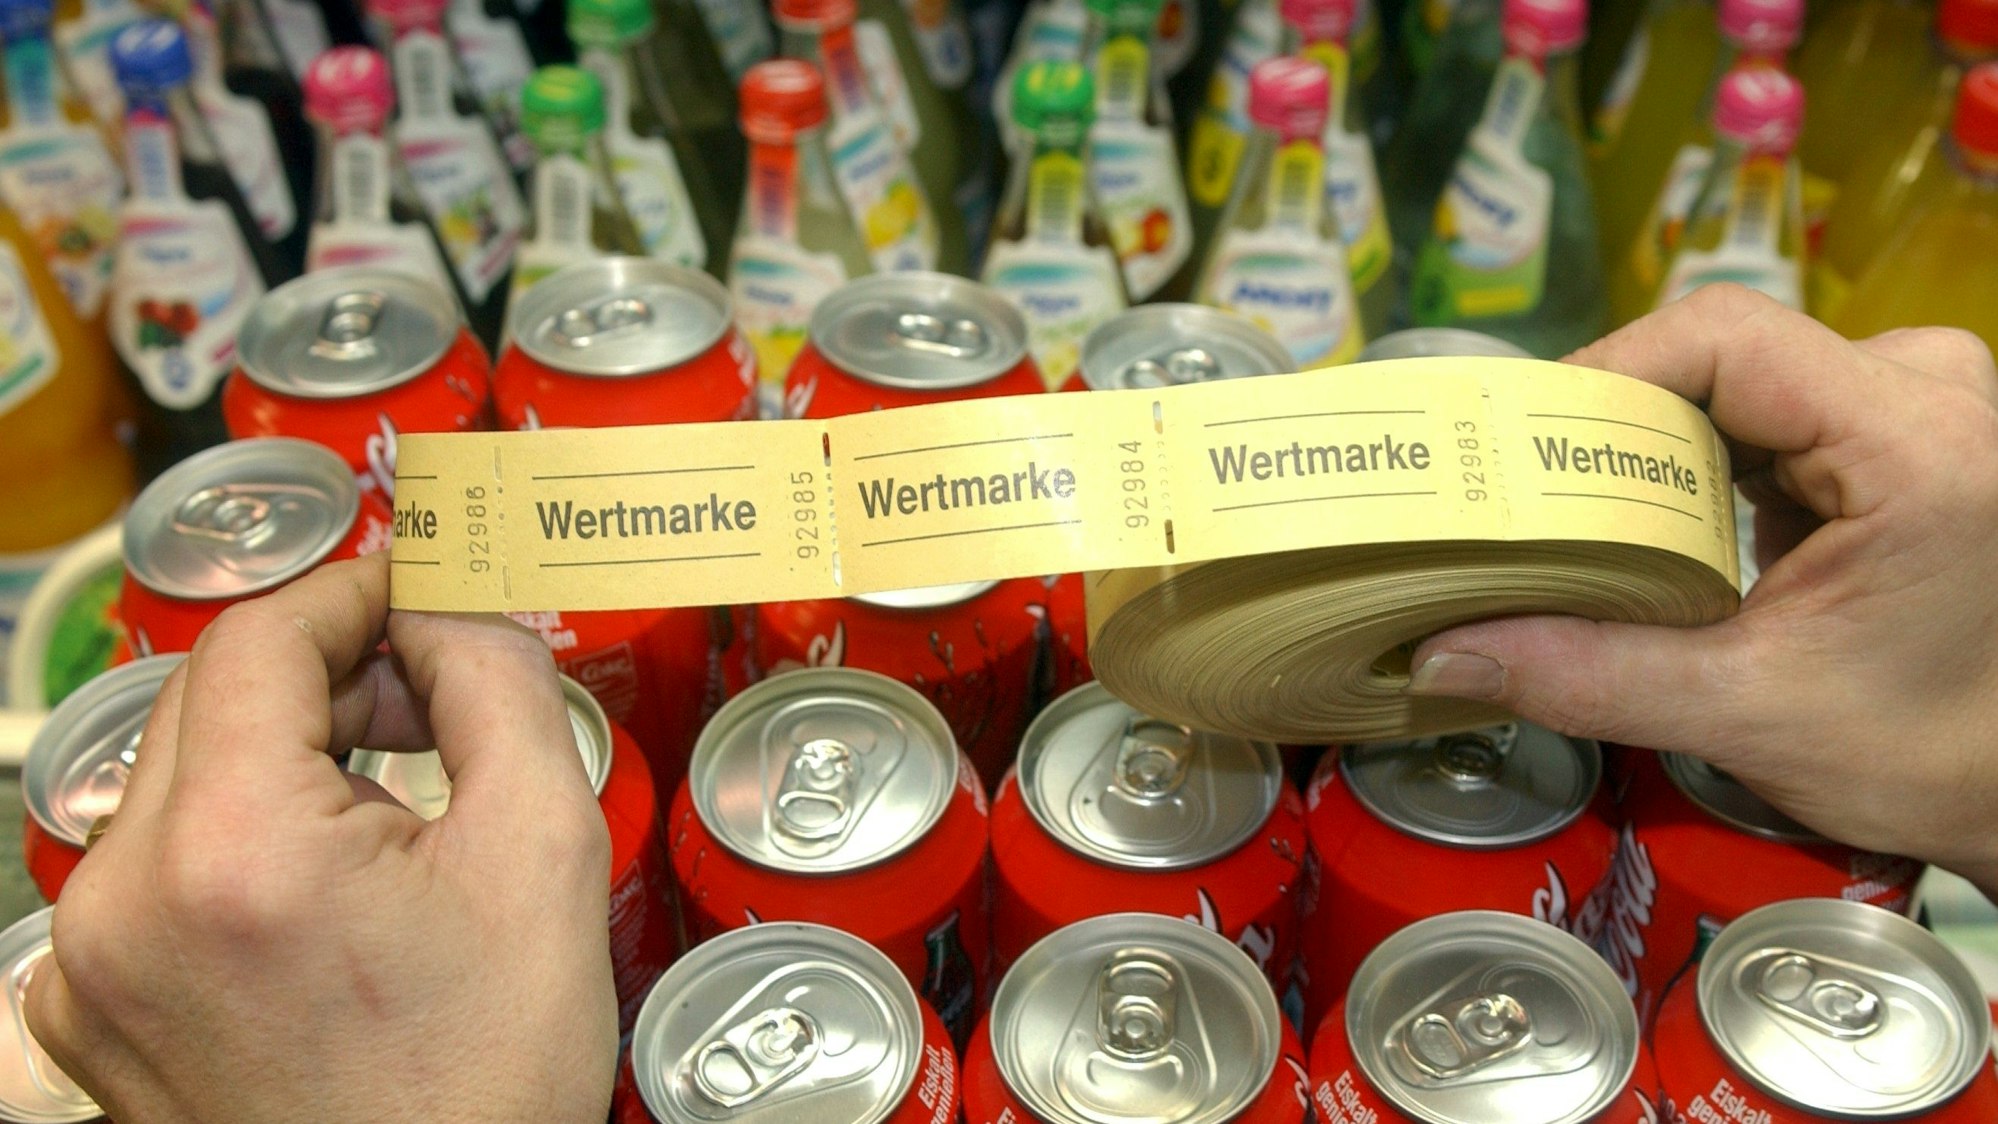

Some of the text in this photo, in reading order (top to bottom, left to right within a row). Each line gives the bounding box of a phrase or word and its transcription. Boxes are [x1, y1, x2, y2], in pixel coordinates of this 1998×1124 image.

[857, 461, 1077, 519] Wertmarke
[1118, 439, 1150, 530] 92984
[1208, 434, 1431, 485] Wertmarke
[1453, 419, 1488, 502] 92983
[1532, 435, 1698, 496] Wertmarke
[466, 485, 491, 573] 92986
[535, 493, 757, 540] Wertmarke
[790, 470, 819, 560] 92985
